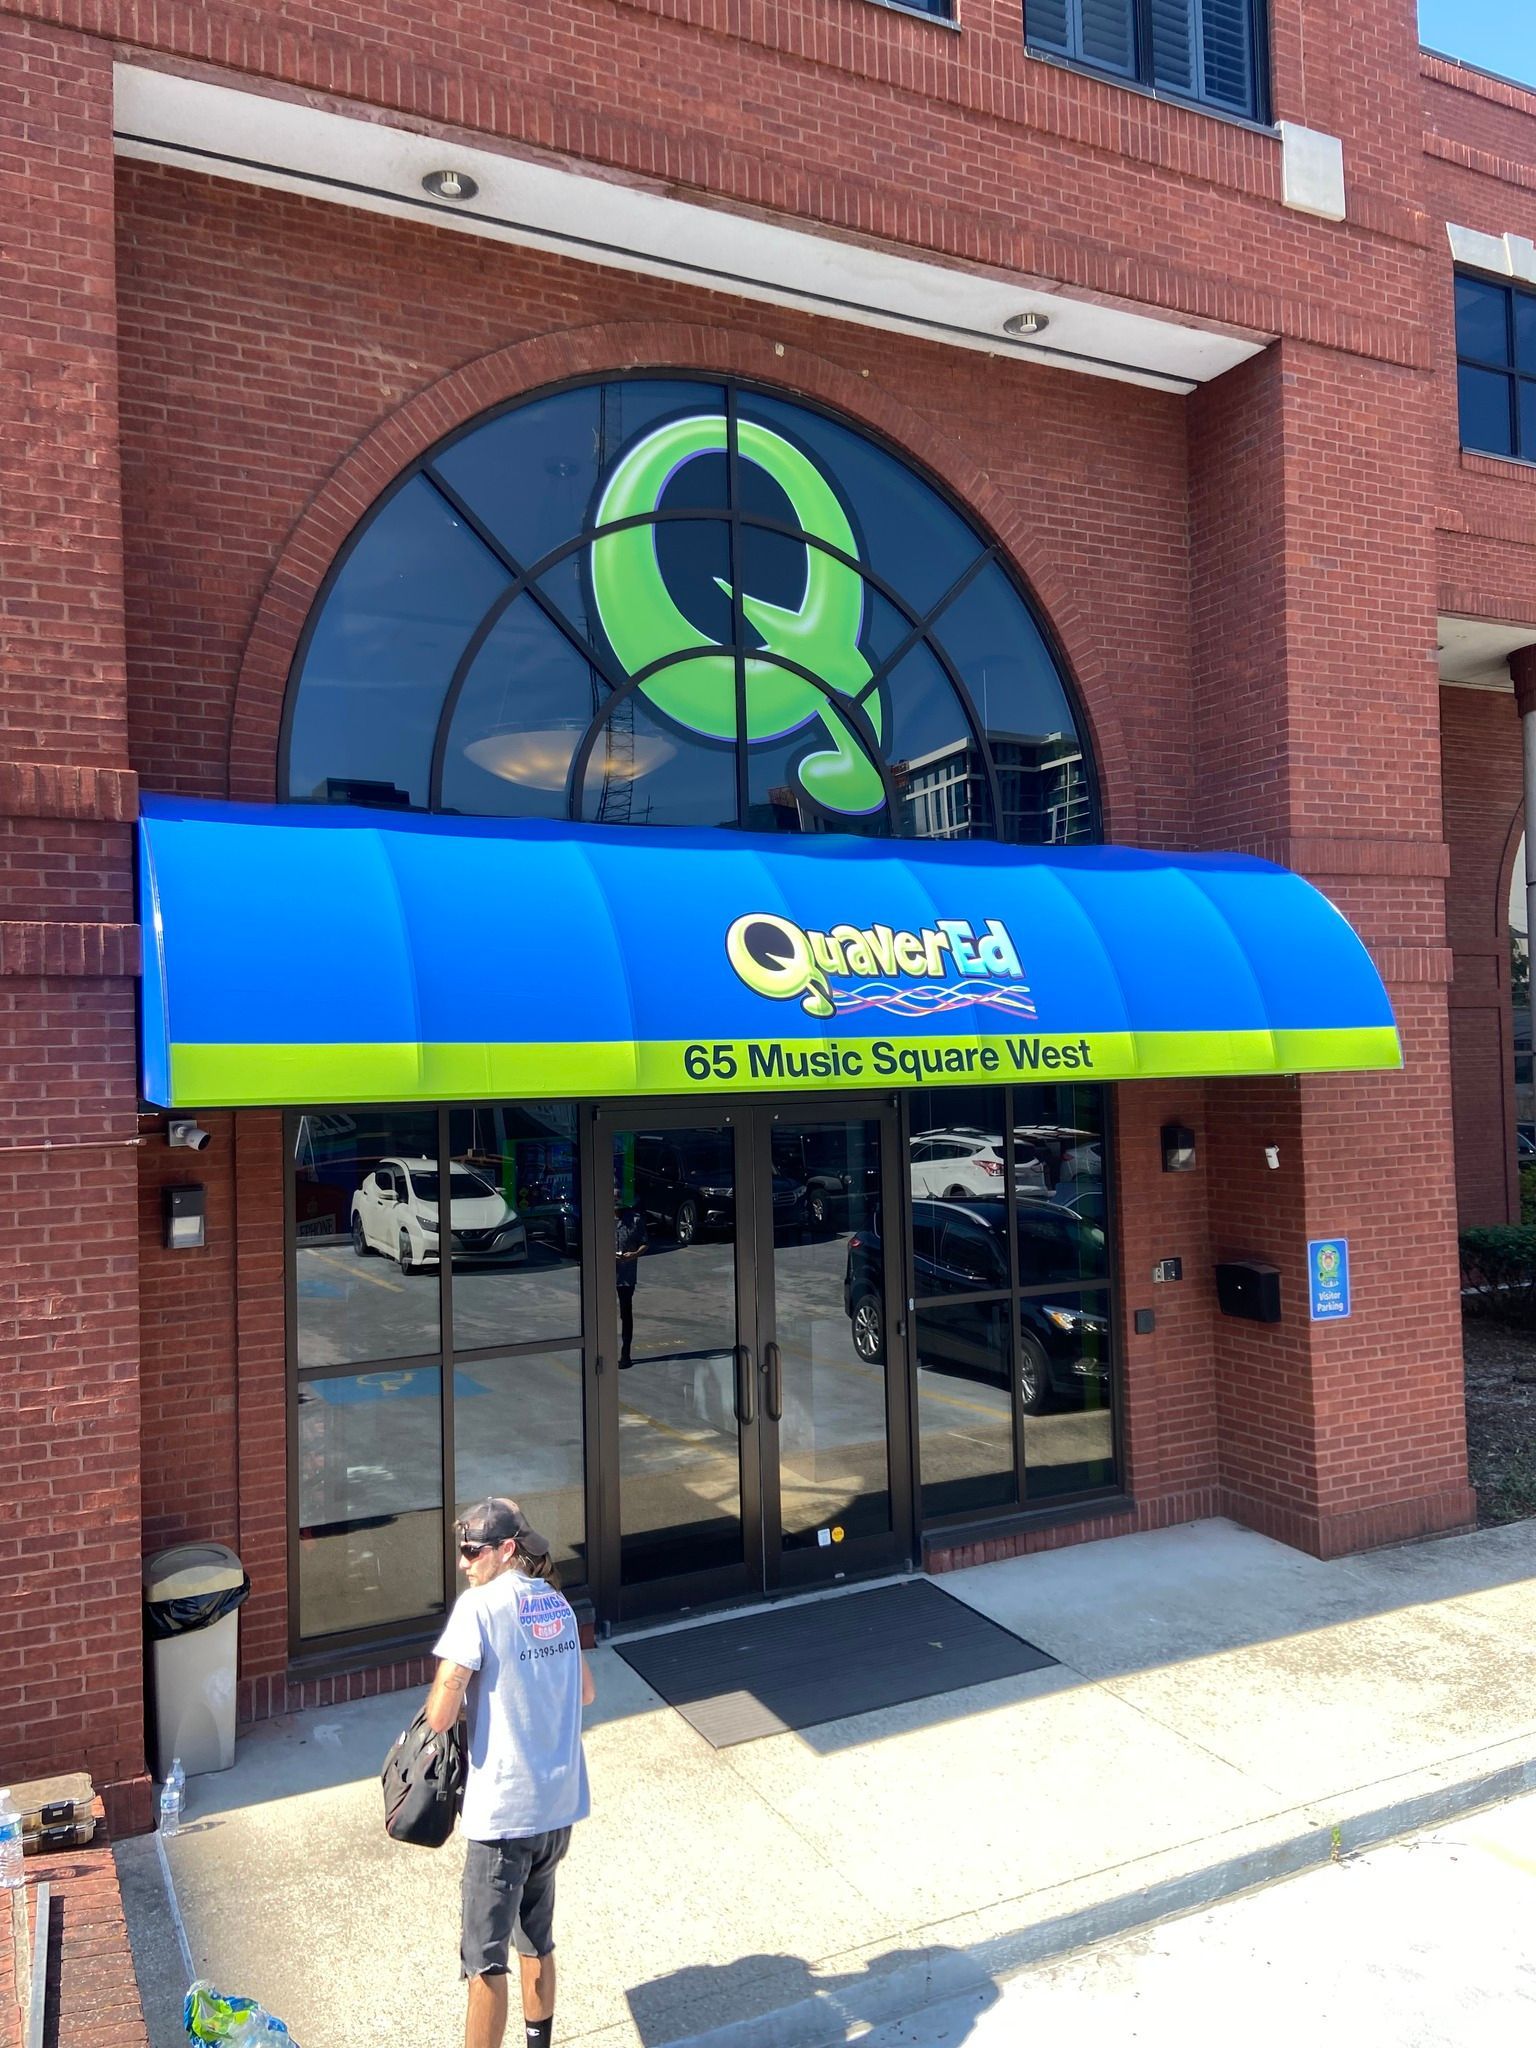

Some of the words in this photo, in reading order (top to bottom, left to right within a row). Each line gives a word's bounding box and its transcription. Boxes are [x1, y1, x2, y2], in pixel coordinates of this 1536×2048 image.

[725, 912, 1025, 1019] QuaverEd
[684, 1044, 738, 1081] 65
[749, 1043, 864, 1079] Music
[873, 1041, 1000, 1081] Square
[1006, 1039, 1094, 1070] West
[1317, 1301, 1344, 1313] Parking
[1319, 1291, 1341, 1301] Visitor
